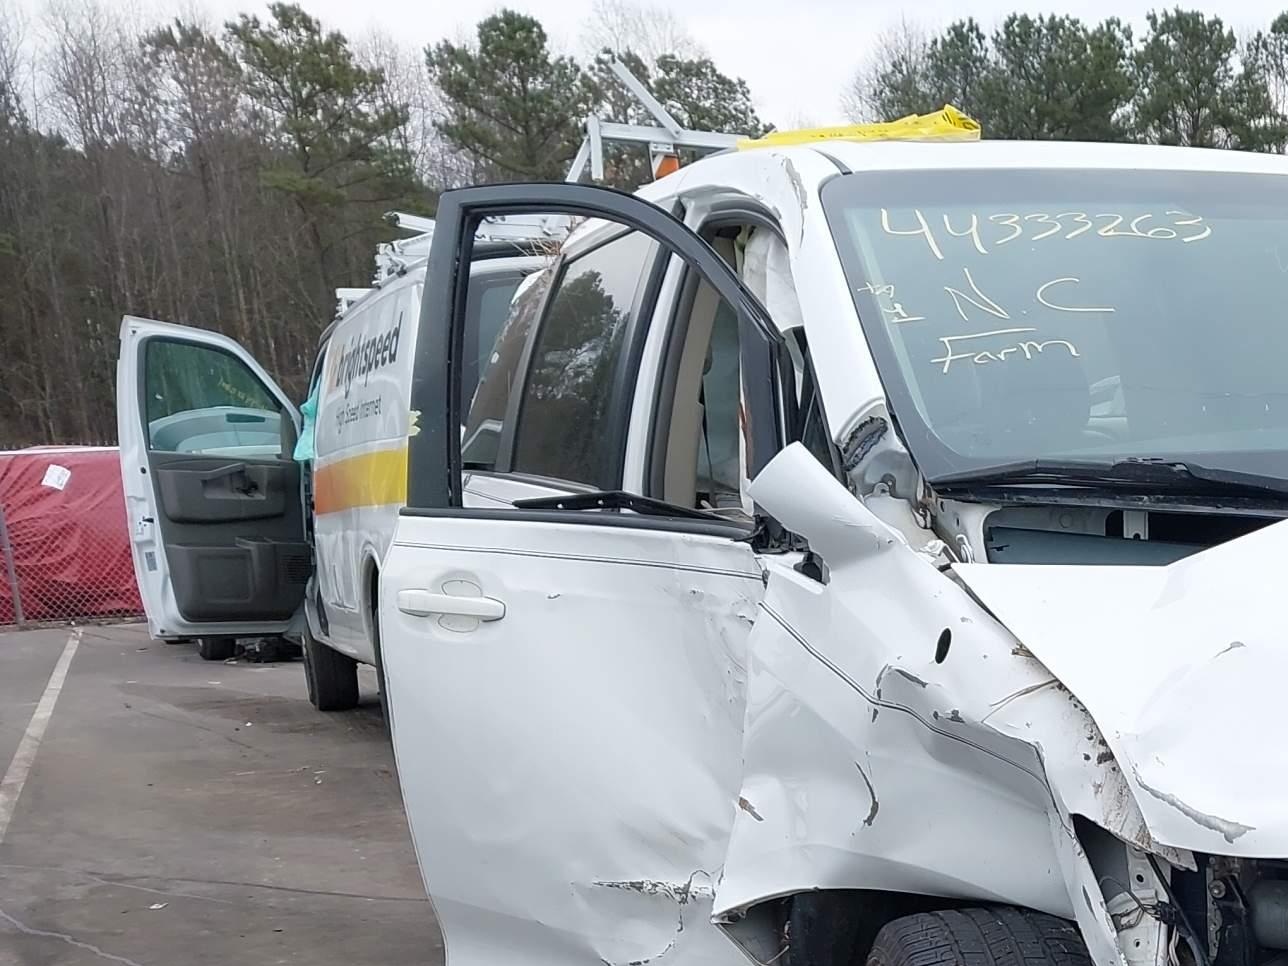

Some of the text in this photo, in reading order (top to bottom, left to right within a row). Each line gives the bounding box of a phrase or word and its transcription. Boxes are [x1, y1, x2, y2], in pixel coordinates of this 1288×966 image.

[880, 208, 1212, 260] 44333263
[335, 311, 404, 399] brightspeed
[931, 327, 1081, 374] Farm
